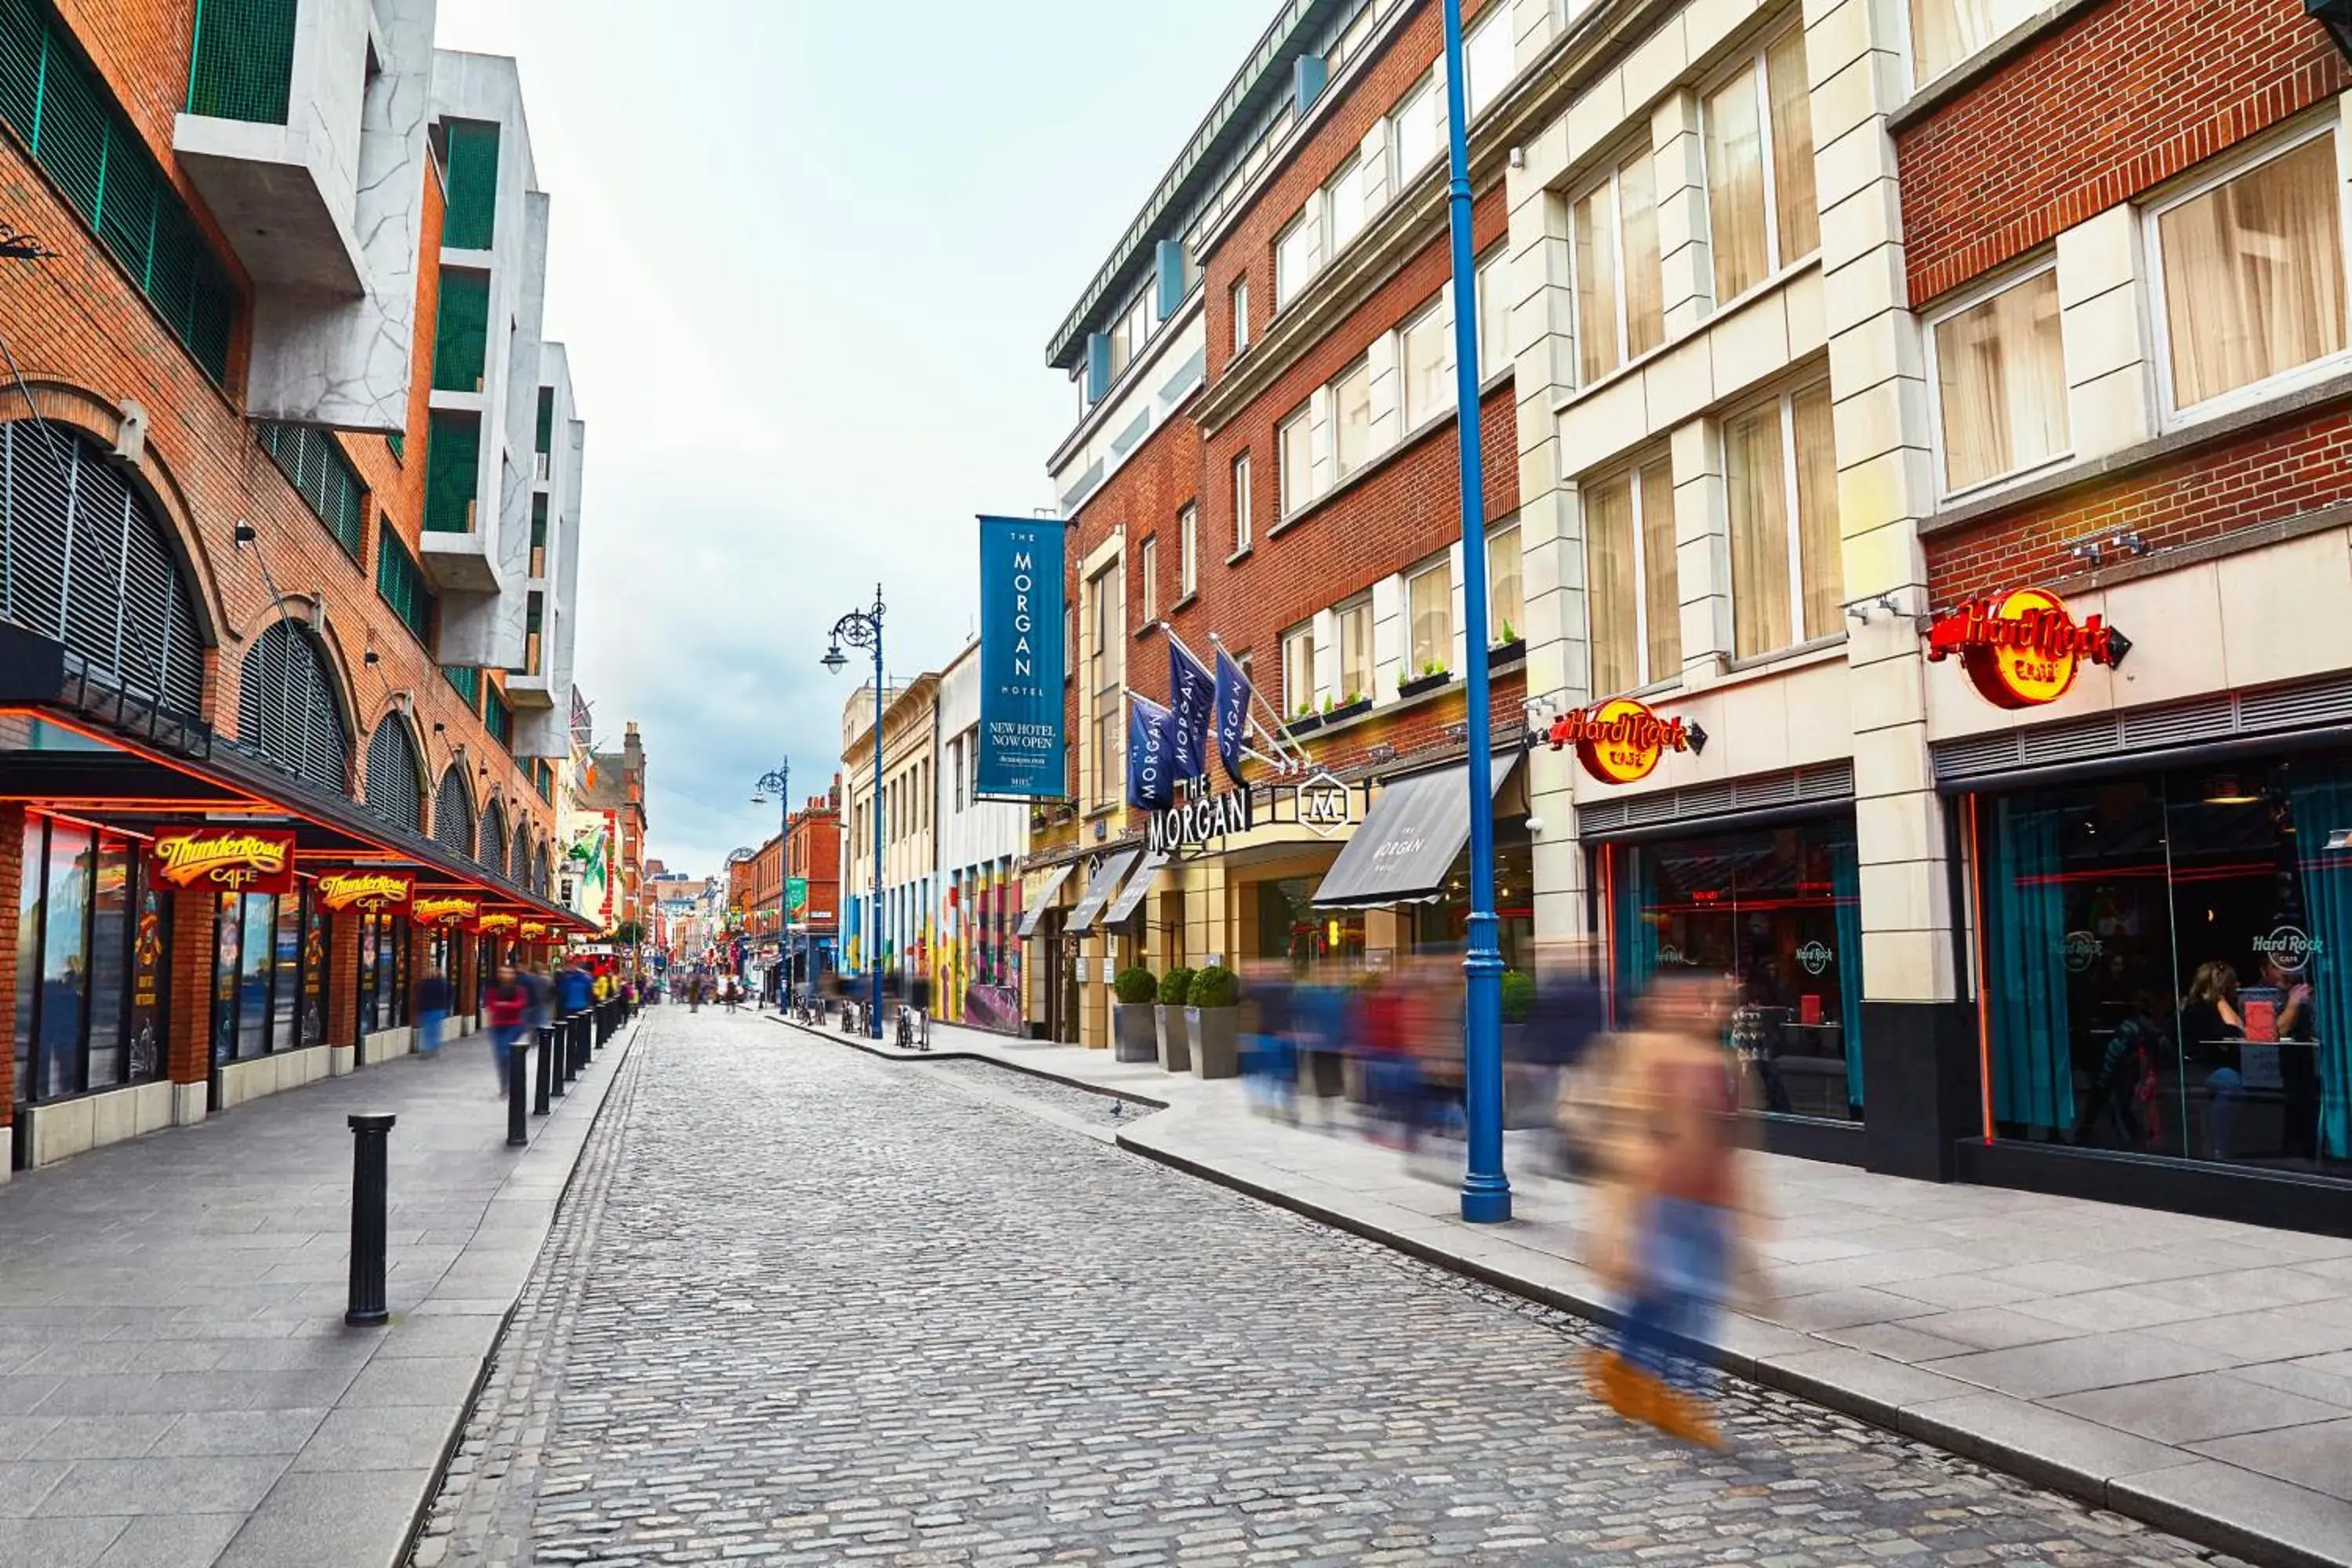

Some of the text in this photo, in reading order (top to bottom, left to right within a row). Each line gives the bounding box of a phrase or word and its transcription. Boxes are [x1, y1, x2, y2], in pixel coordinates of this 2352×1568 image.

[1010, 532, 1035, 542] THE
[1014, 551, 1033, 677] MORGAN
[1964, 602, 2112, 665] Hard Rock
[1001, 686, 1044, 697] HOTEL
[989, 722, 1055, 737] NEW HOTEL
[1224, 681, 1242, 757] ORGAN
[1568, 709, 1687, 753] Hard Rock
[993, 735, 1053, 749] NOW OPEN
[1141, 714, 1163, 800] MORGAN
[1183, 773, 1207, 800] THE
[1149, 787, 1247, 852] MORGAN
[2252, 935, 2323, 954] Hard Rock
